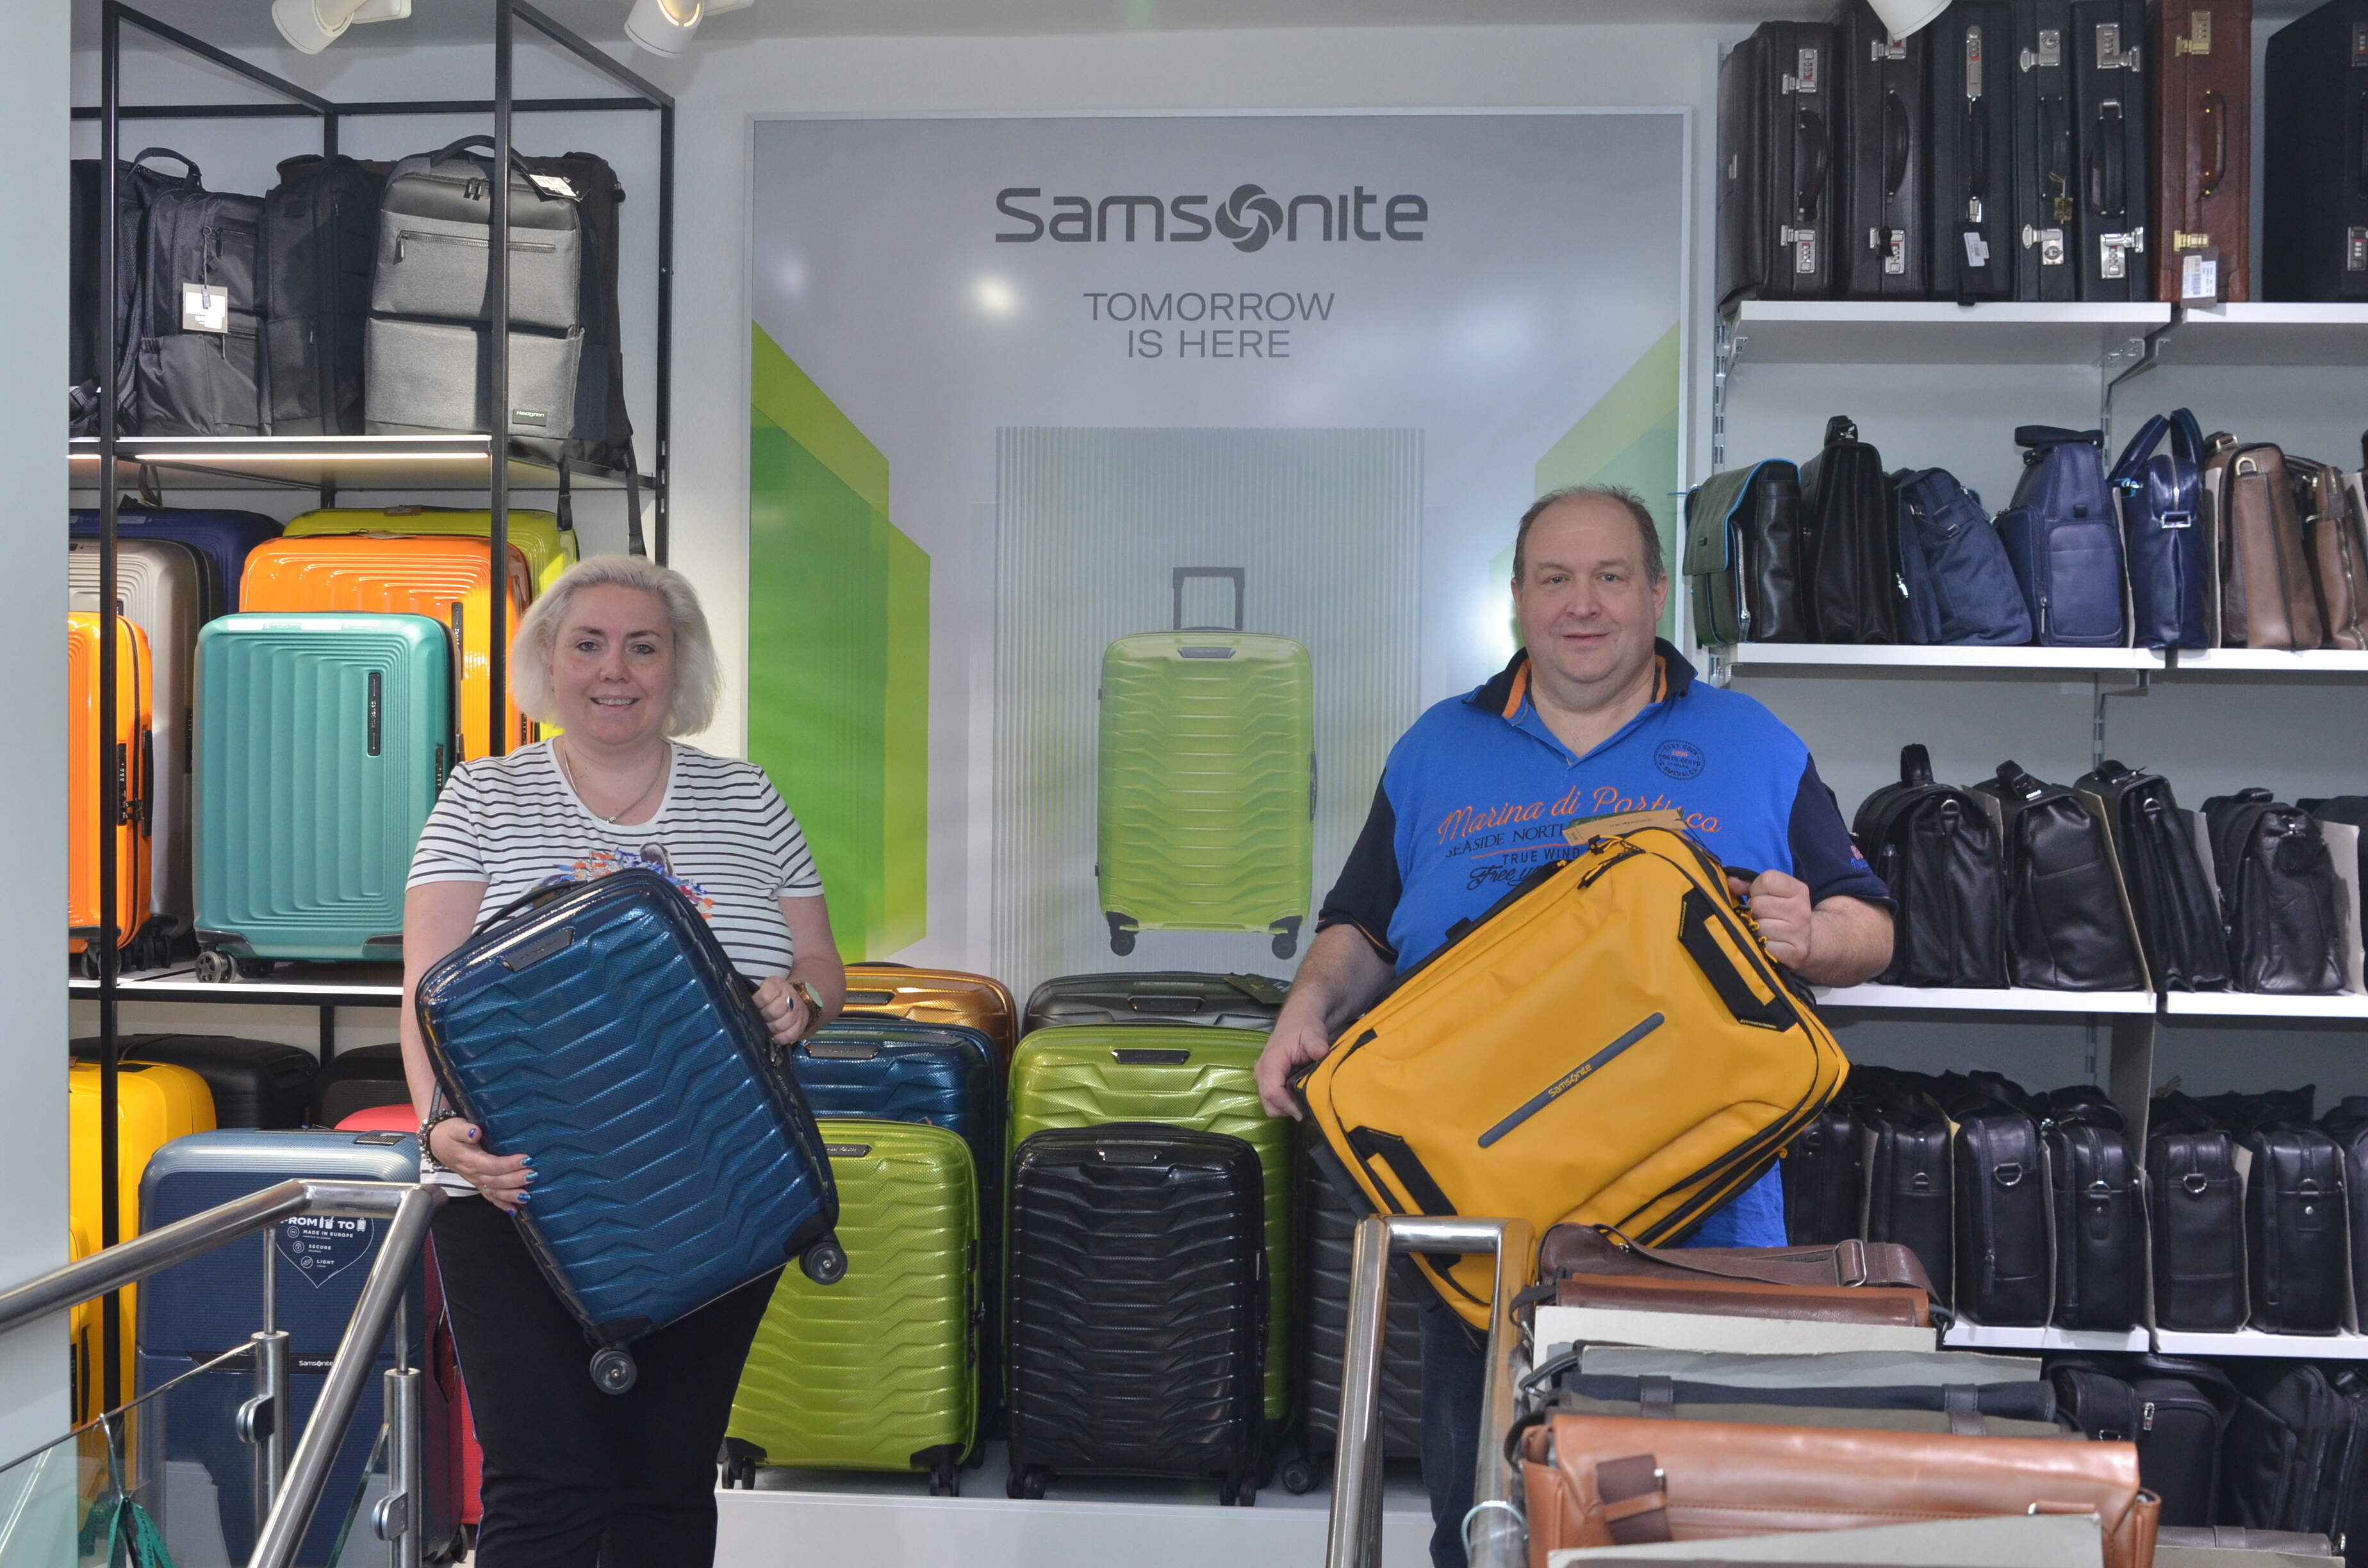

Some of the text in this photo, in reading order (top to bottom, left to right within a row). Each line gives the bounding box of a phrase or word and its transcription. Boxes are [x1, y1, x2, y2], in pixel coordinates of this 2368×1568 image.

[995, 183, 1429, 253] Samsonite
[1083, 292, 1335, 322] TOMORROW
[1128, 329, 1290, 359] IS HERE
[1437, 784, 1723, 846] Marina di Portico
[1502, 847, 1581, 865] TRUE WIND
[1467, 865, 1516, 890] Free
[1548, 1064, 1593, 1097] Samsonite
[337, 1220, 356, 1230] TO
